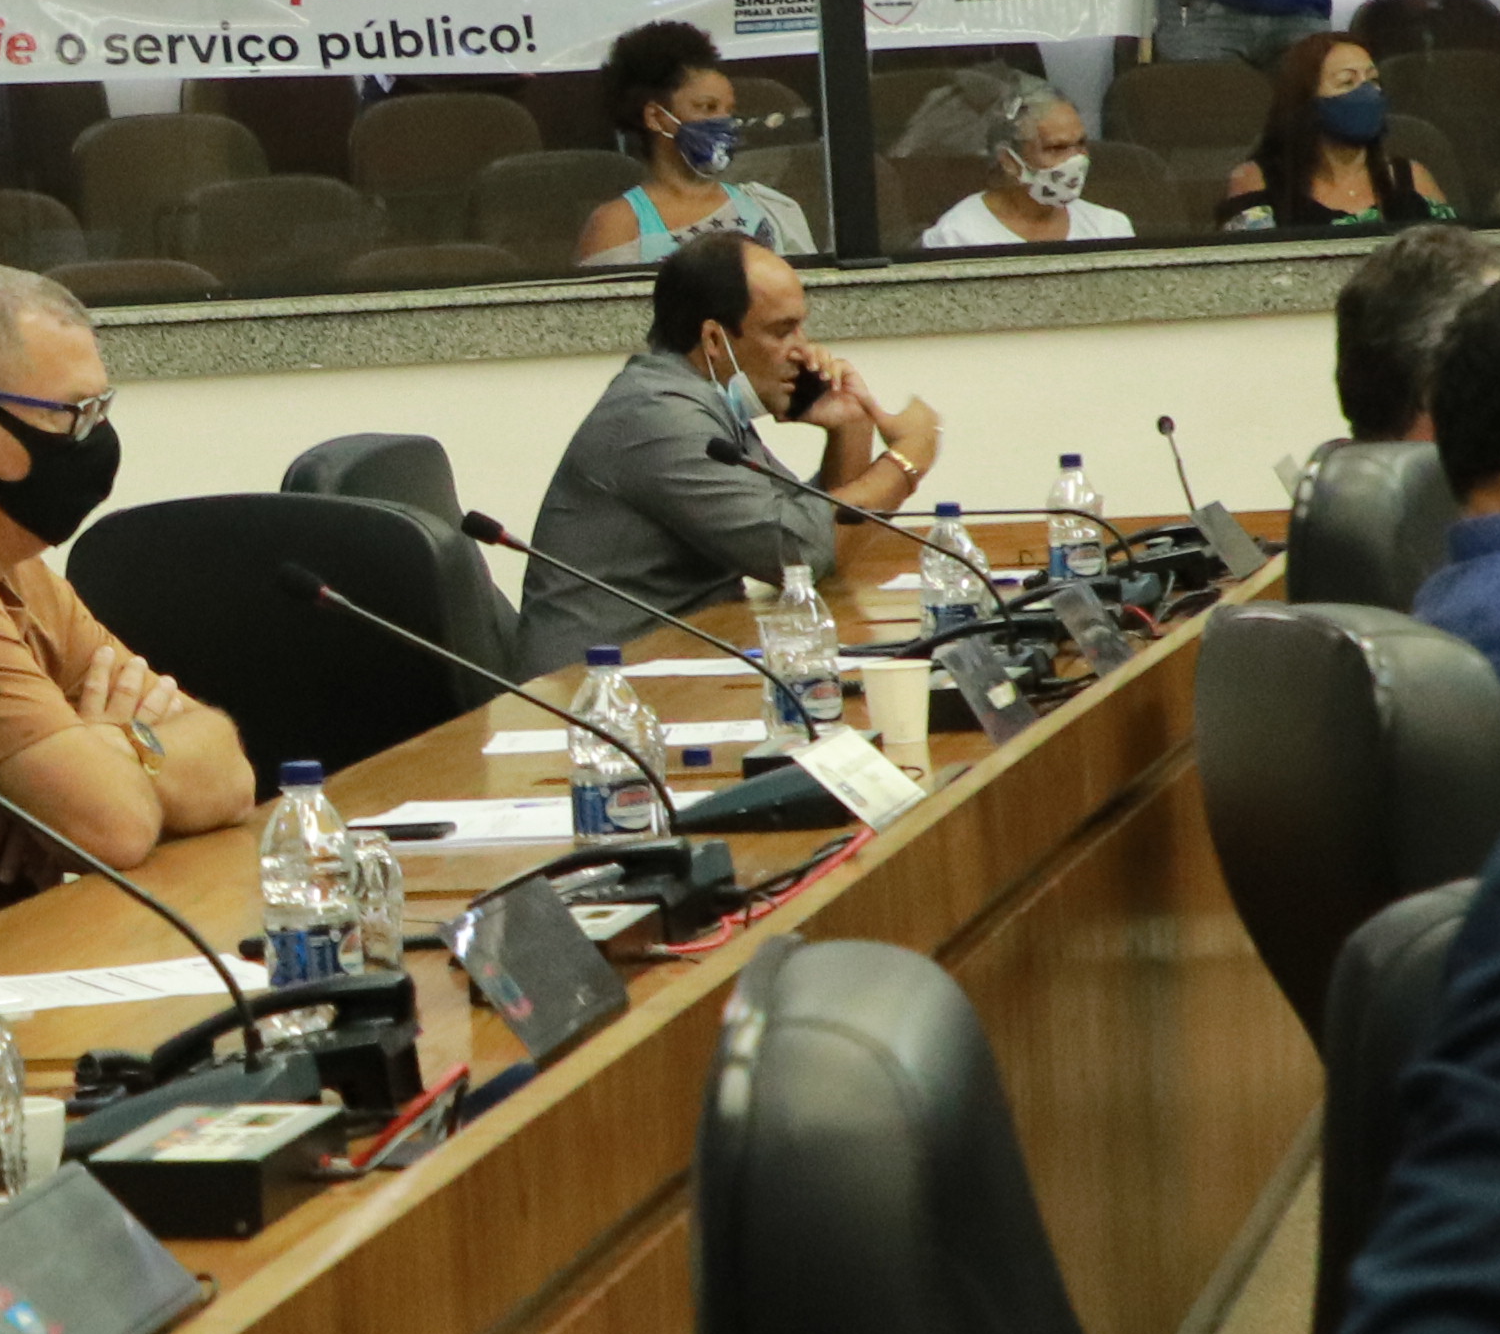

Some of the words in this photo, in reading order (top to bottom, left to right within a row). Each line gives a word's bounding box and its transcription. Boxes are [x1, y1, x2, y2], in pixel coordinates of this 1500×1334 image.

[55, 32, 88, 66] o
[103, 19, 300, 73] serviço
[317, 14, 538, 69] público!
